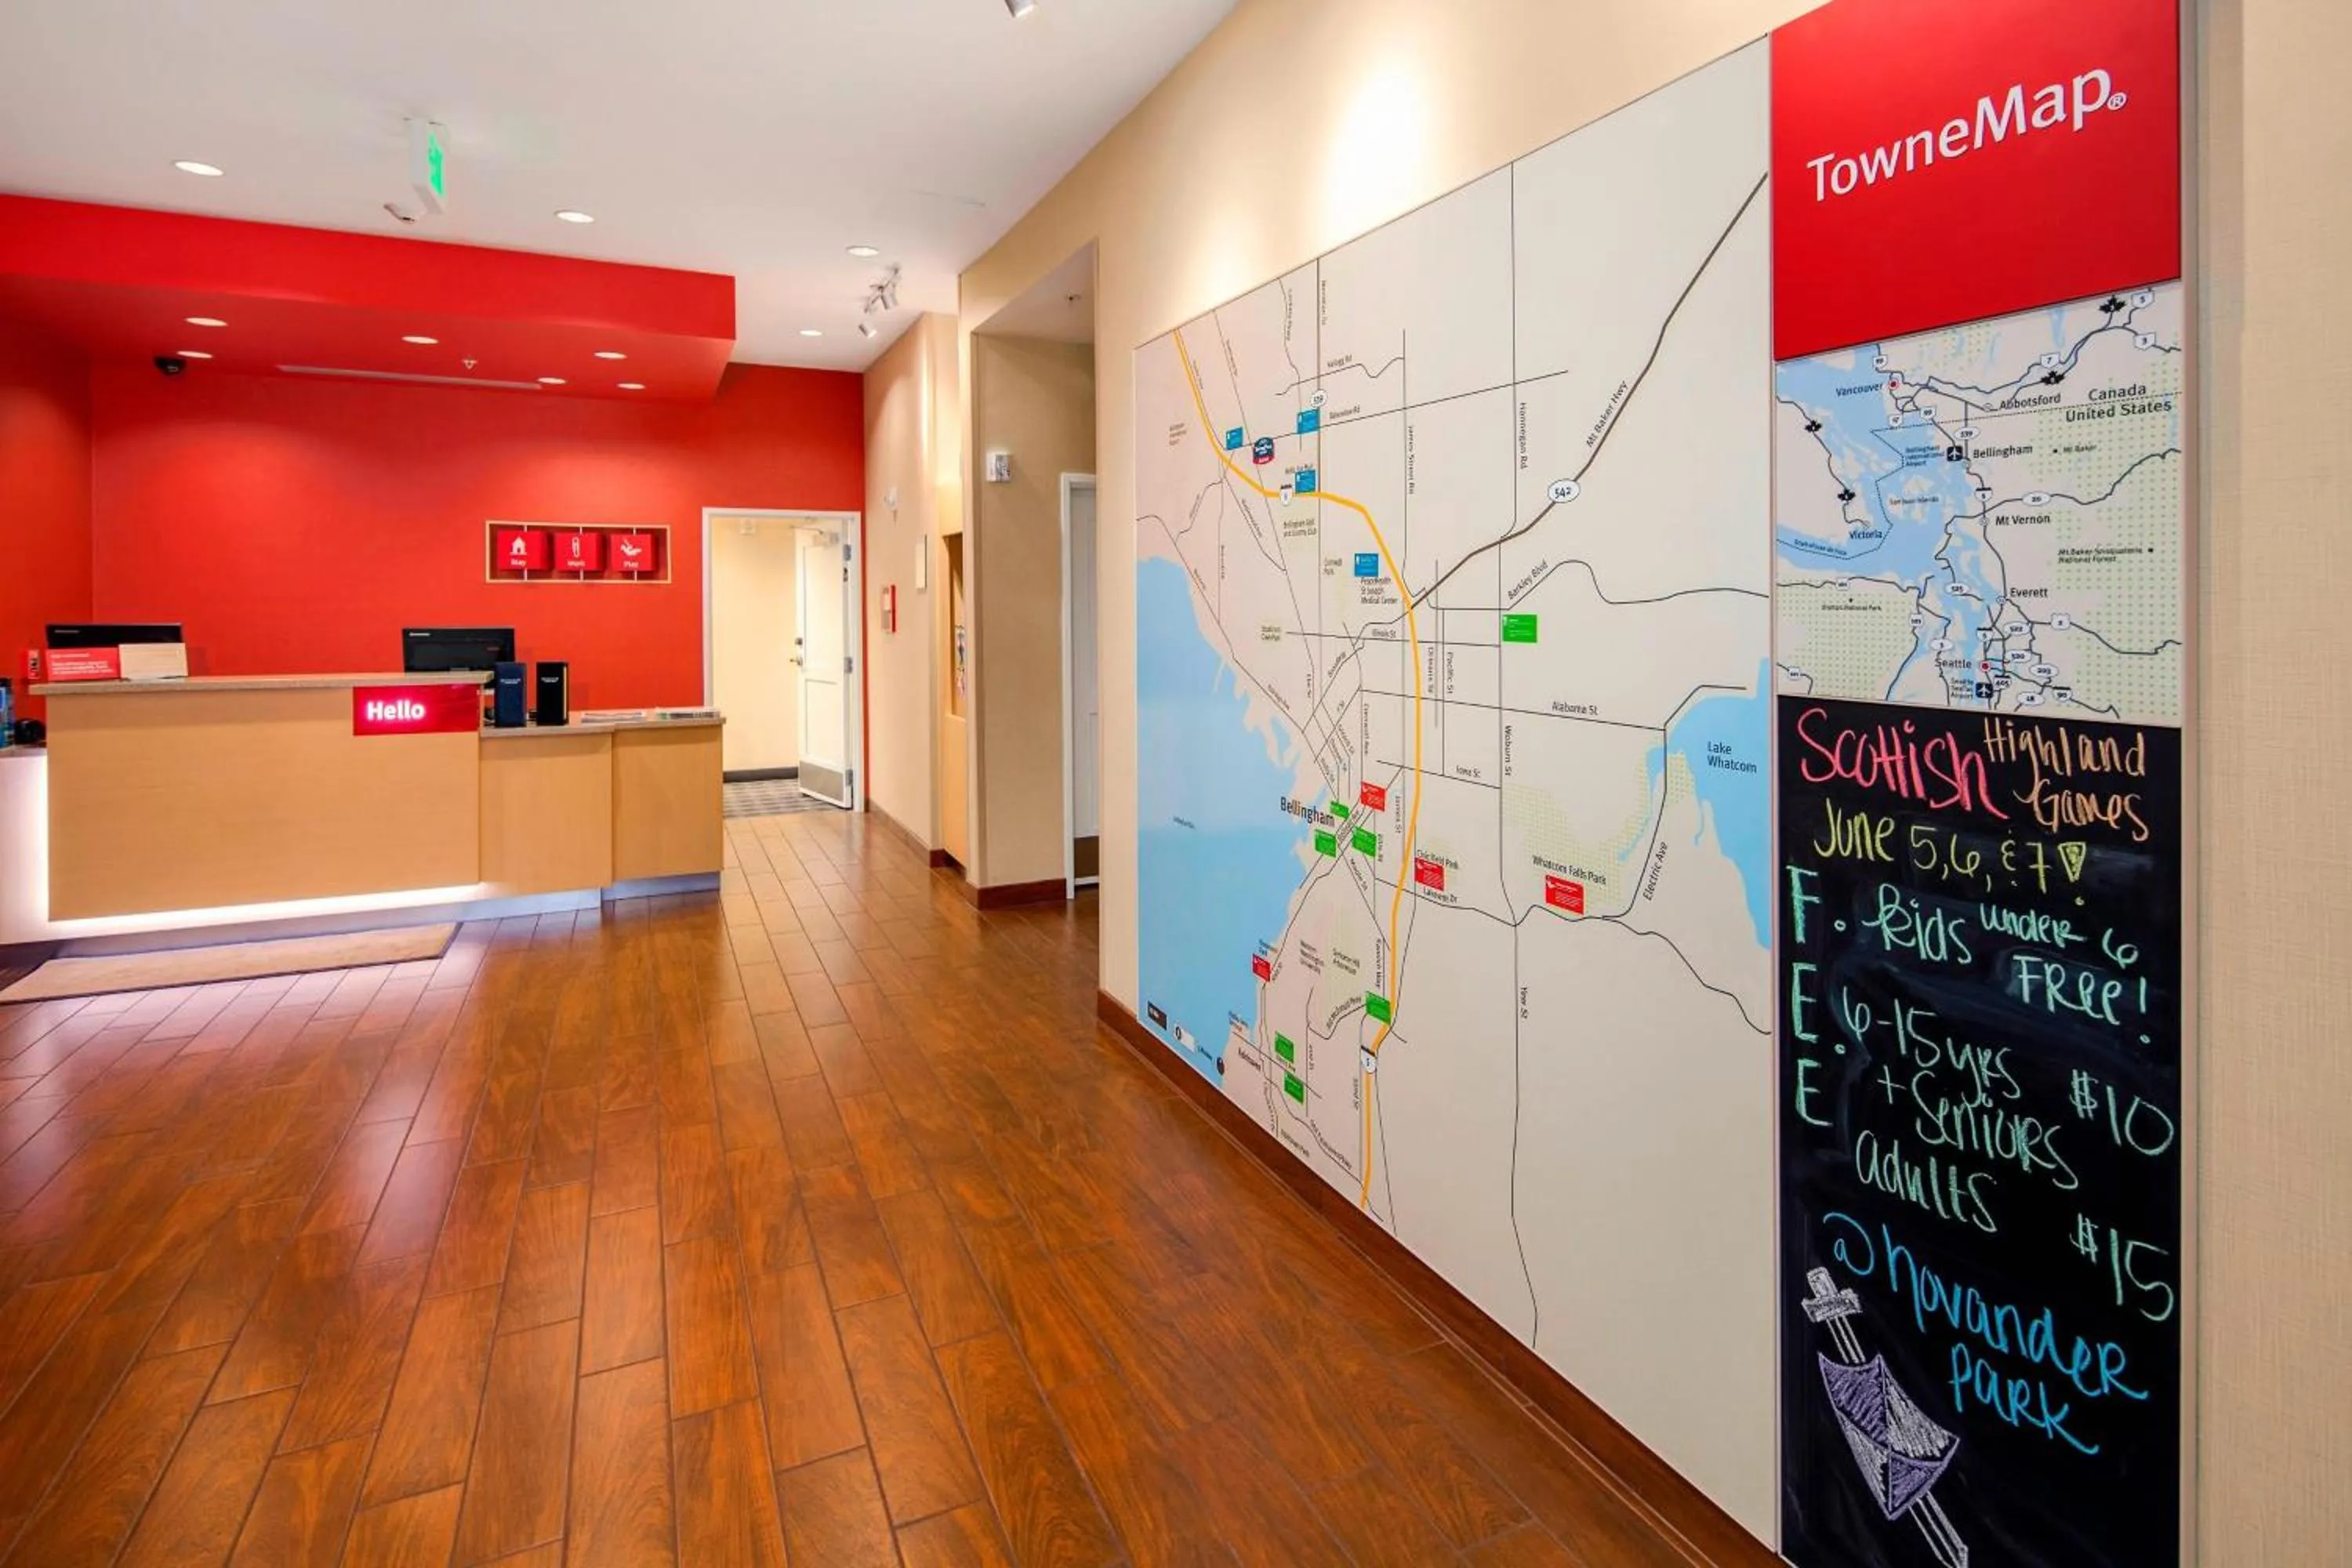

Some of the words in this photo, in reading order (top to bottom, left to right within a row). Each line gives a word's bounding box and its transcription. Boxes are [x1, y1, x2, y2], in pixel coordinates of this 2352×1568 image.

[1835, 383, 1882, 397] Vancouver
[2088, 383, 2147, 401] Canada
[1595, 405, 1613, 434] Baker
[1610, 380, 1628, 404] Hwy
[1999, 394, 2061, 409] Abbotsford
[2065, 405, 2116, 423] United
[2119, 401, 2172, 416] States
[1973, 445, 2033, 459] Bellingham
[1554, 486, 1572, 499] 542
[1995, 515, 2009, 526] Mt
[2012, 514, 2051, 525] Vernon
[1849, 530, 1882, 540] Victoria
[1508, 576, 1533, 601] Barkley
[1531, 560, 1548, 579] Blvd
[2009, 588, 2049, 597] Everett
[1935, 659, 1973, 669] Seattle
[367, 701, 426, 721] Hello
[1588, 705, 1599, 716] St
[1707, 741, 1732, 755] Lake
[1707, 755, 1758, 774] Whatcom
[1797, 707, 2009, 820] Scottish
[1983, 716, 2145, 804] Highland
[1279, 797, 1335, 827] Bellingham
[2033, 779, 2151, 842] Games
[1813, 797, 1895, 862] June
[1568, 863, 1588, 880] Falls
[1588, 869, 1607, 886] Park
[1642, 862, 1662, 902] Electric
[1655, 841, 1668, 863] Ave
[2102, 927, 2140, 970] 6
[2070, 1068, 2174, 1156] $10
[2068, 1213, 2174, 1322] $15
